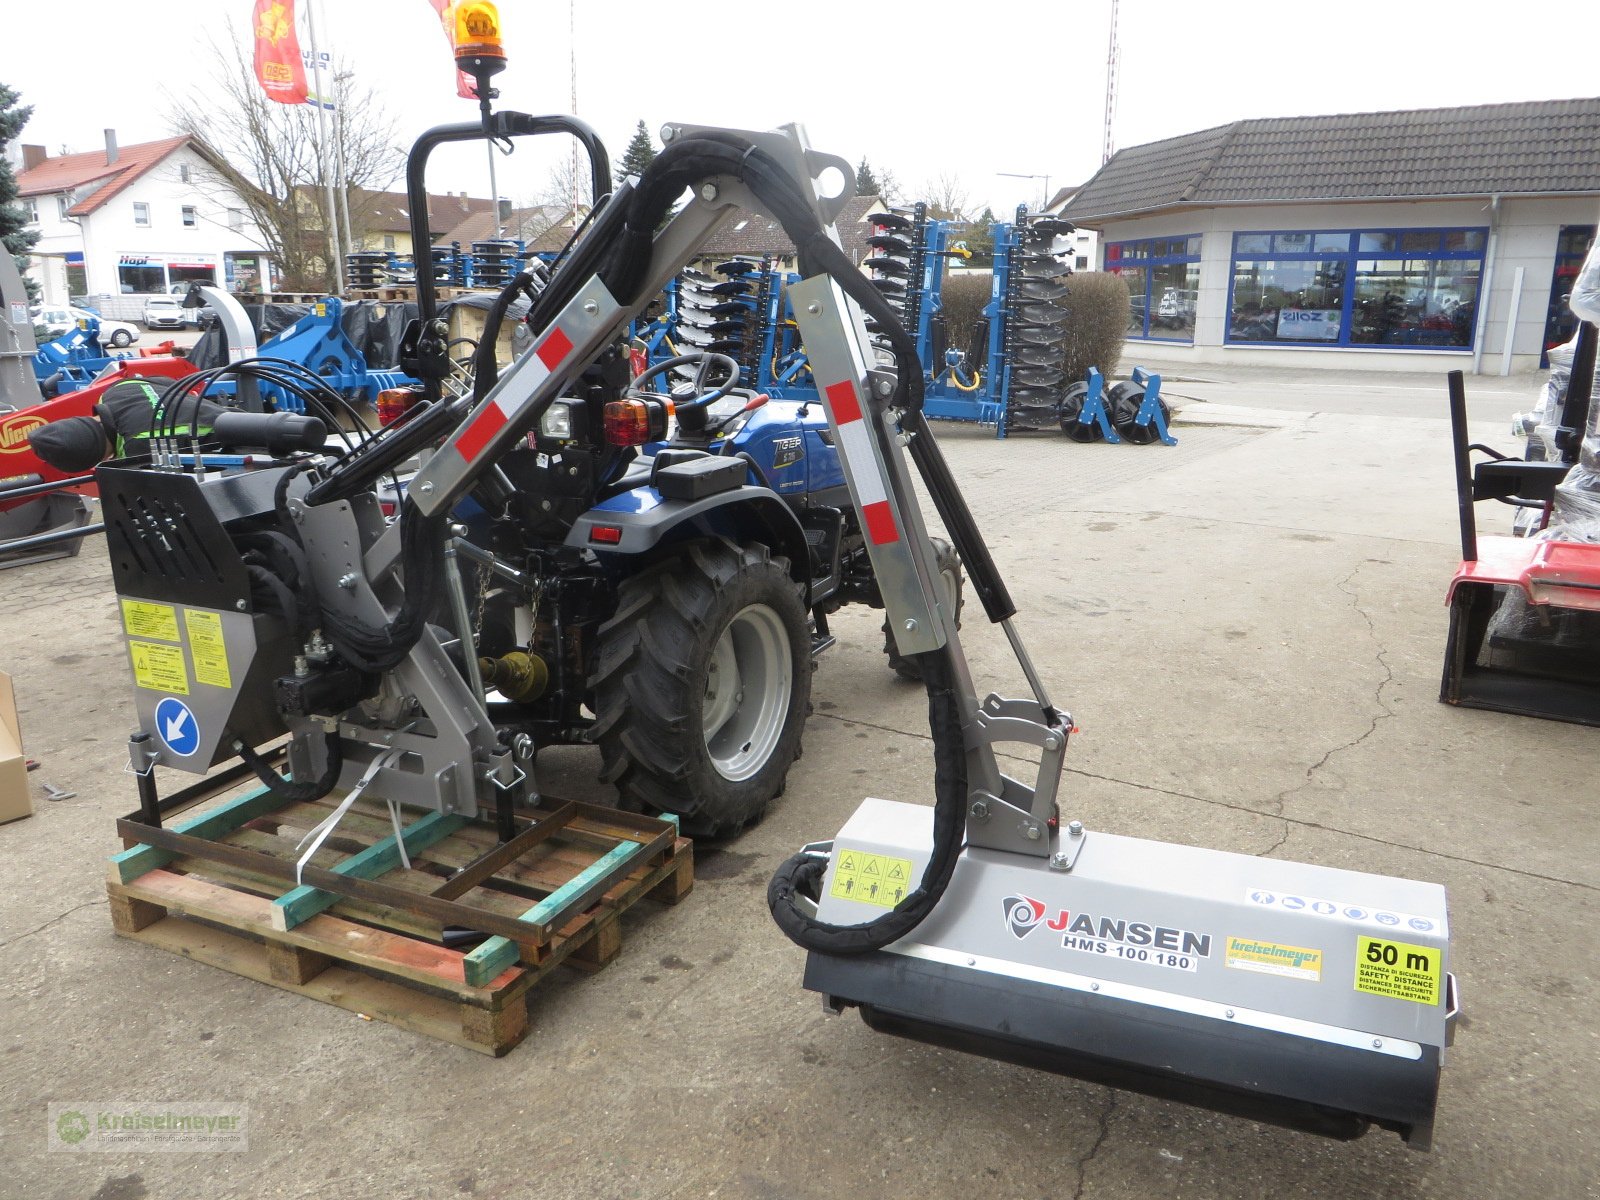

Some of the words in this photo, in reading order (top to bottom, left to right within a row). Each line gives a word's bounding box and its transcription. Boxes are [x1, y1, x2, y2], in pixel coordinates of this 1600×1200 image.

[1046, 910, 1211, 957] JANSEN
[1231, 939, 1319, 967] kreiselmeyer
[1366, 941, 1398, 966] 50
[1406, 953, 1429, 972] m
[1359, 969, 1390, 980] SAFETY
[1394, 976, 1433, 988] DISTANCE
[1360, 963, 1390, 974] DISTANZA
[1399, 970, 1433, 981] SICUREZZA
[1358, 984, 1431, 1001] SICHERHEITSABSTAND
[1359, 977, 1392, 987] DISTANCES
[1403, 985, 1433, 995] SECURITE
